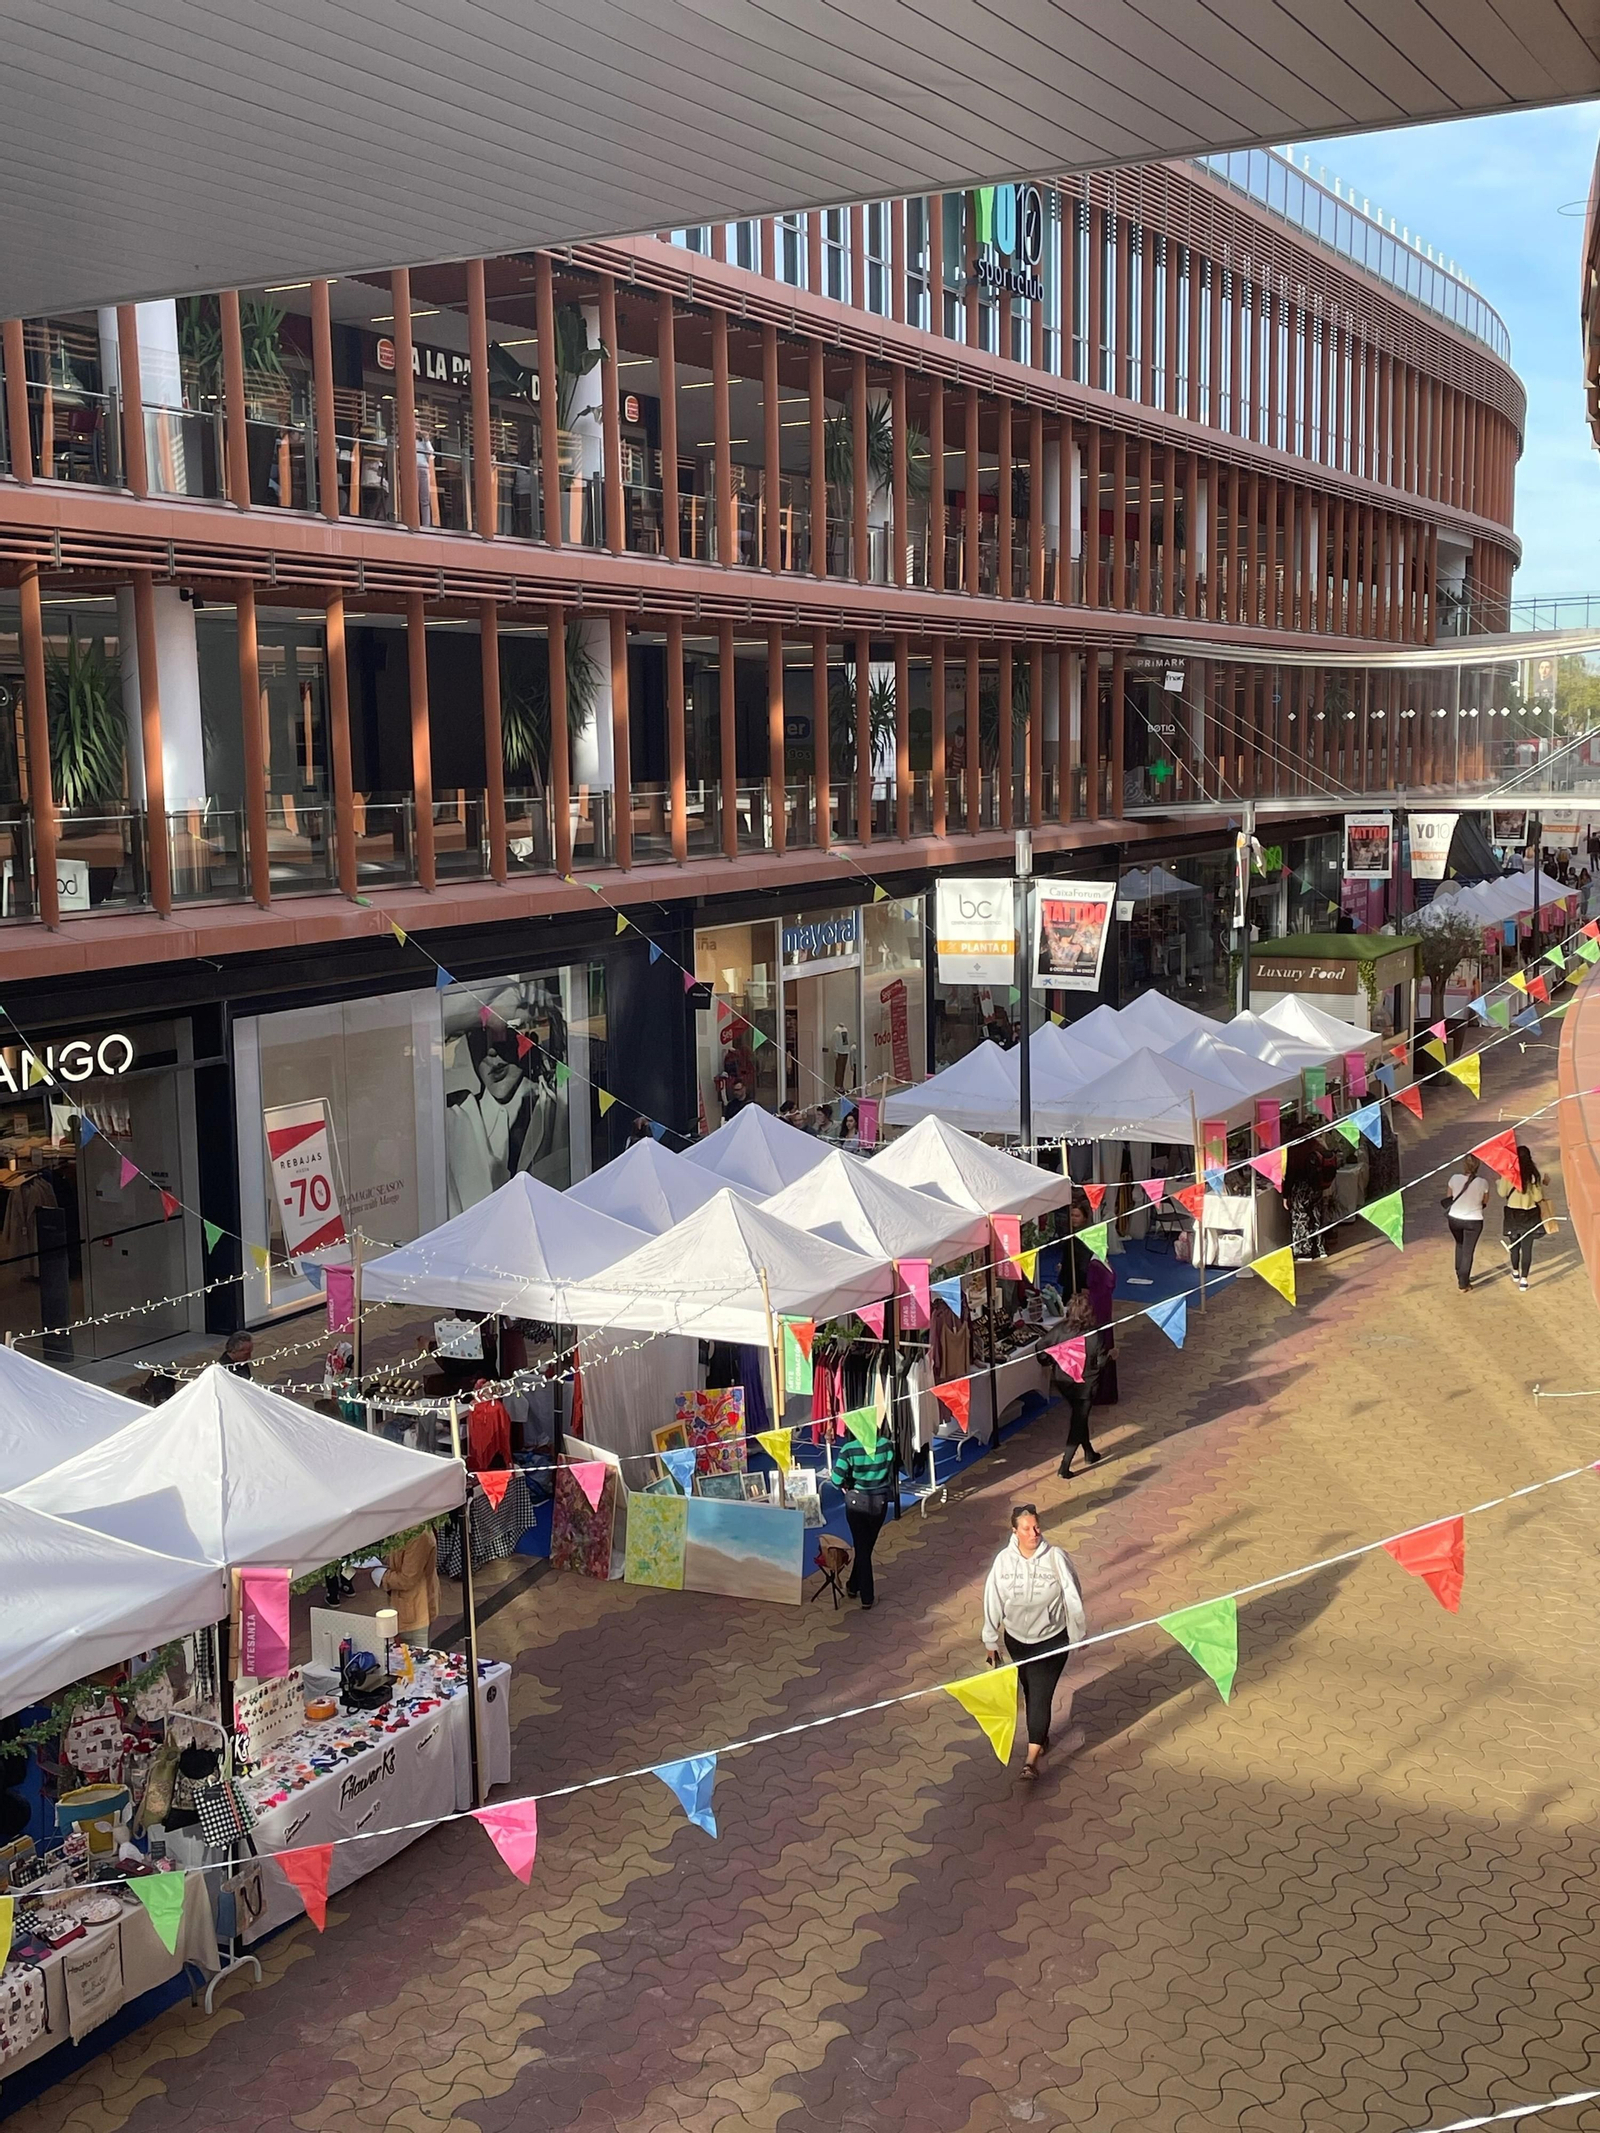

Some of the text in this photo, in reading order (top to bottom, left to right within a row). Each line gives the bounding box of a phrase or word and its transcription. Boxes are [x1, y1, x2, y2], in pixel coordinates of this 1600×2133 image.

[427, 350, 447, 382] LA
[1137, 658, 1185, 667] PRIMARK
[1350, 826, 1388, 840] TATTOO
[1416, 823, 1450, 839] YO10
[1050, 887, 1101, 899] CaixaForum
[959, 894, 992, 919] bc
[1042, 901, 1106, 923] TATTOO
[782, 909, 859, 957] mayoral
[961, 943, 1000, 954] PLANTA
[1257, 965, 1346, 982] Luxury Food
[280, 1152, 323, 1169] REBAJAS
[376, 1179, 404, 1197] SEASON
